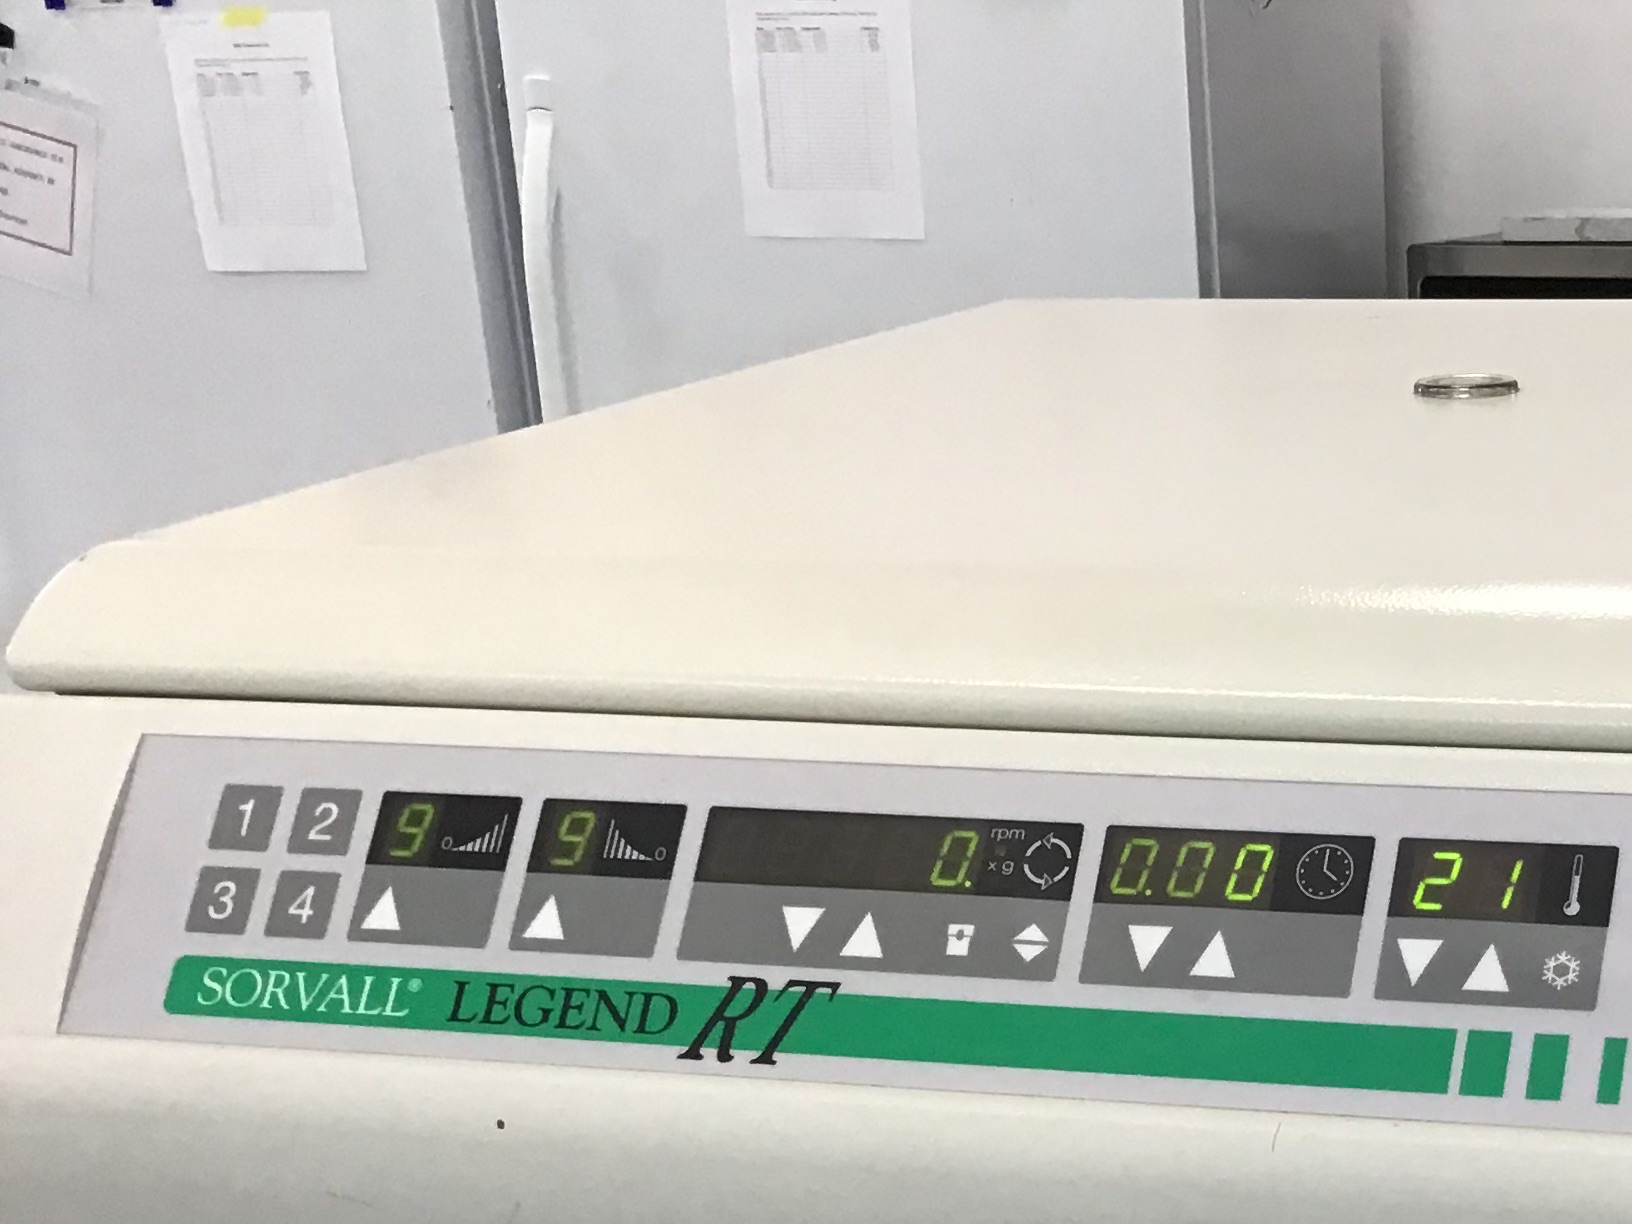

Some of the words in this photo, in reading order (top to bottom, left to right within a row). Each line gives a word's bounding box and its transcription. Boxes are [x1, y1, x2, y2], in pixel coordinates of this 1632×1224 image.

[238, 798, 255, 837] 1
[307, 802, 339, 840] 2
[389, 803, 435, 857] 9
[551, 811, 597, 867] 9
[991, 828, 1026, 842] rpm
[208, 881, 237, 919] 3
[288, 885, 315, 923] 4
[447, 981, 678, 1035] LEGEND
[677, 975, 842, 1066] RT
